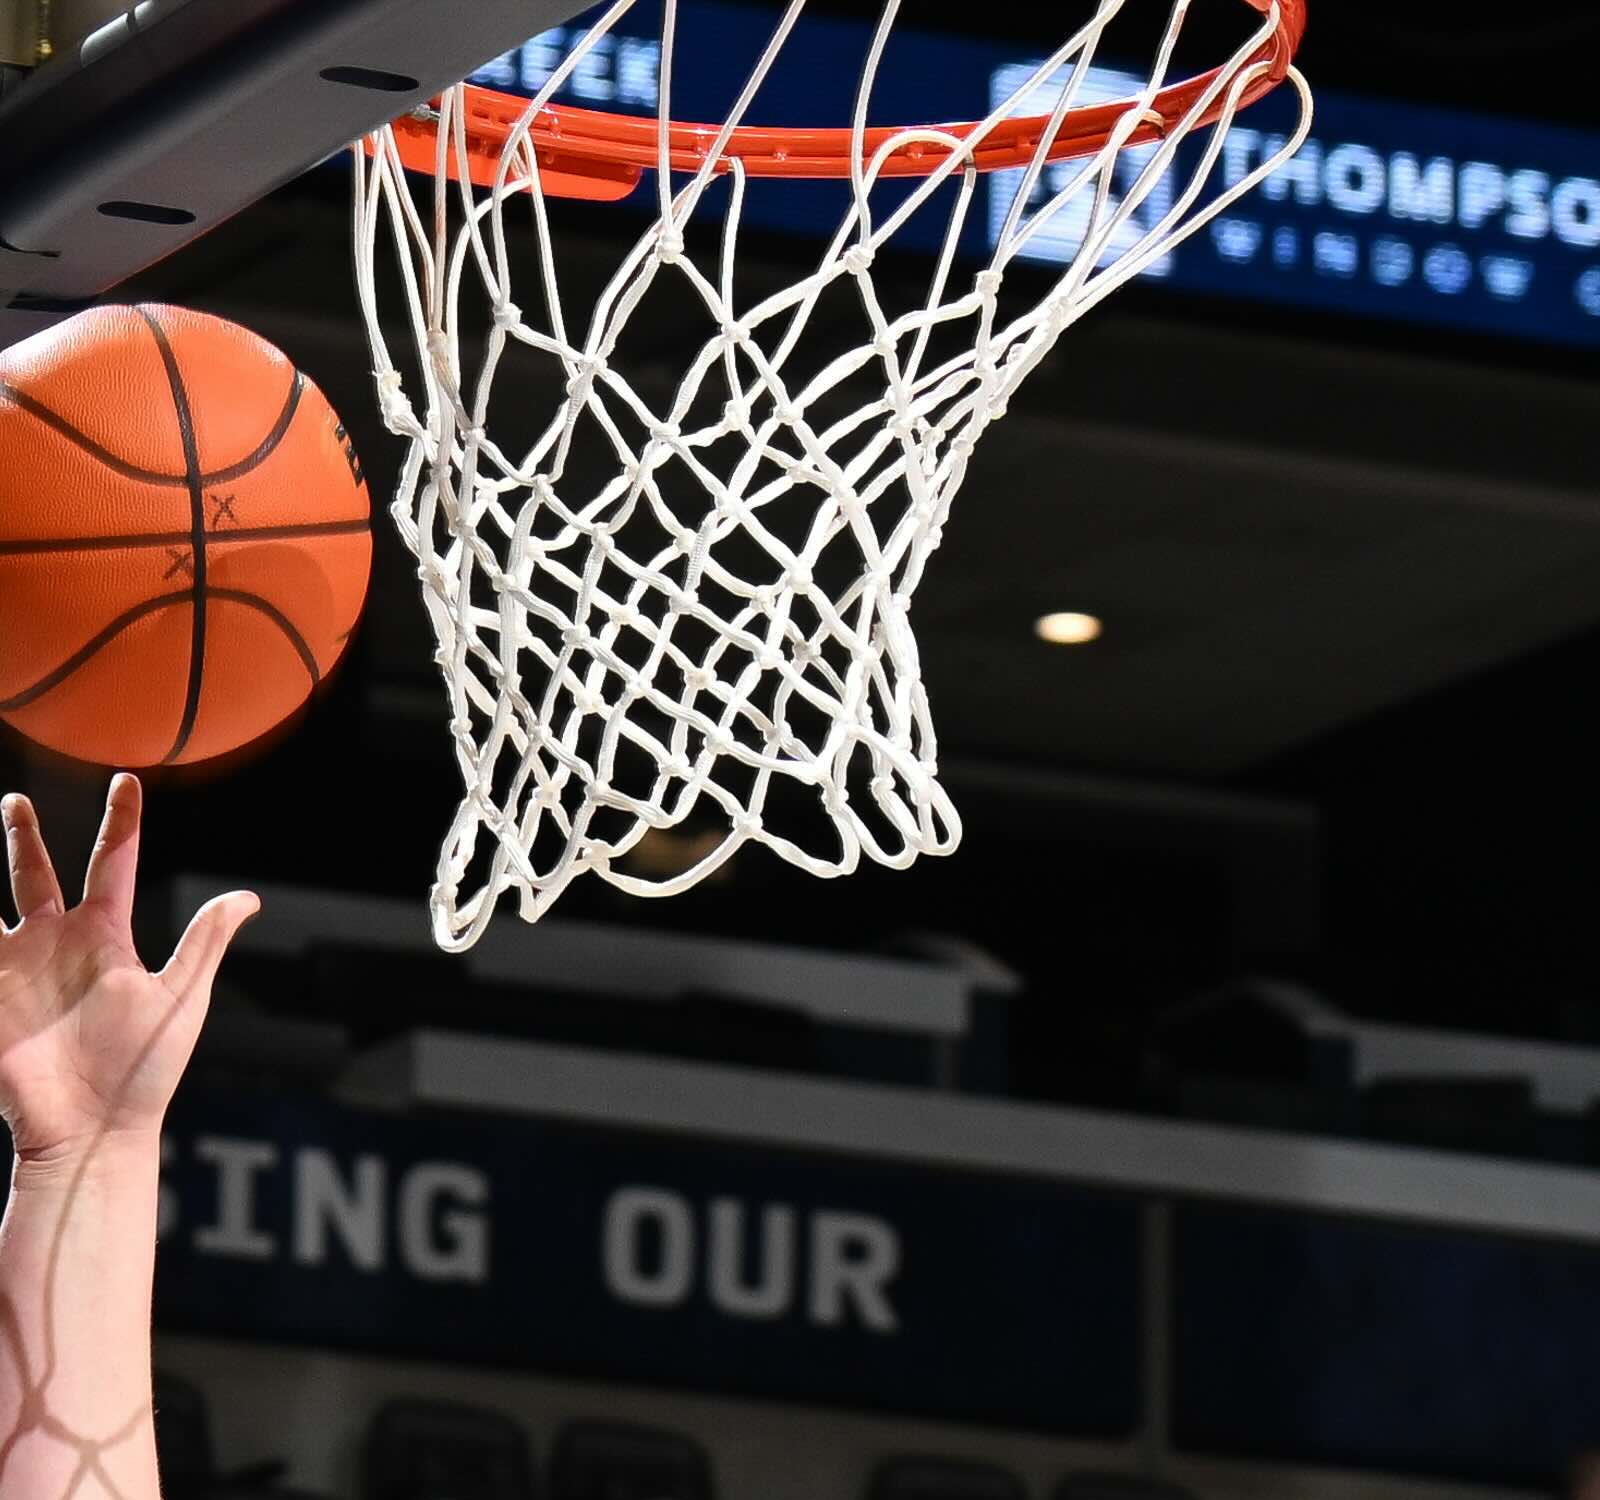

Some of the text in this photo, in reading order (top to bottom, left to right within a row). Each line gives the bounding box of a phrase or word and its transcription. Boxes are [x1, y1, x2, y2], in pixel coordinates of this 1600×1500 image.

[1212, 216, 1532, 299] WINDOW
[157, 1132, 902, 1336] ING OUR
